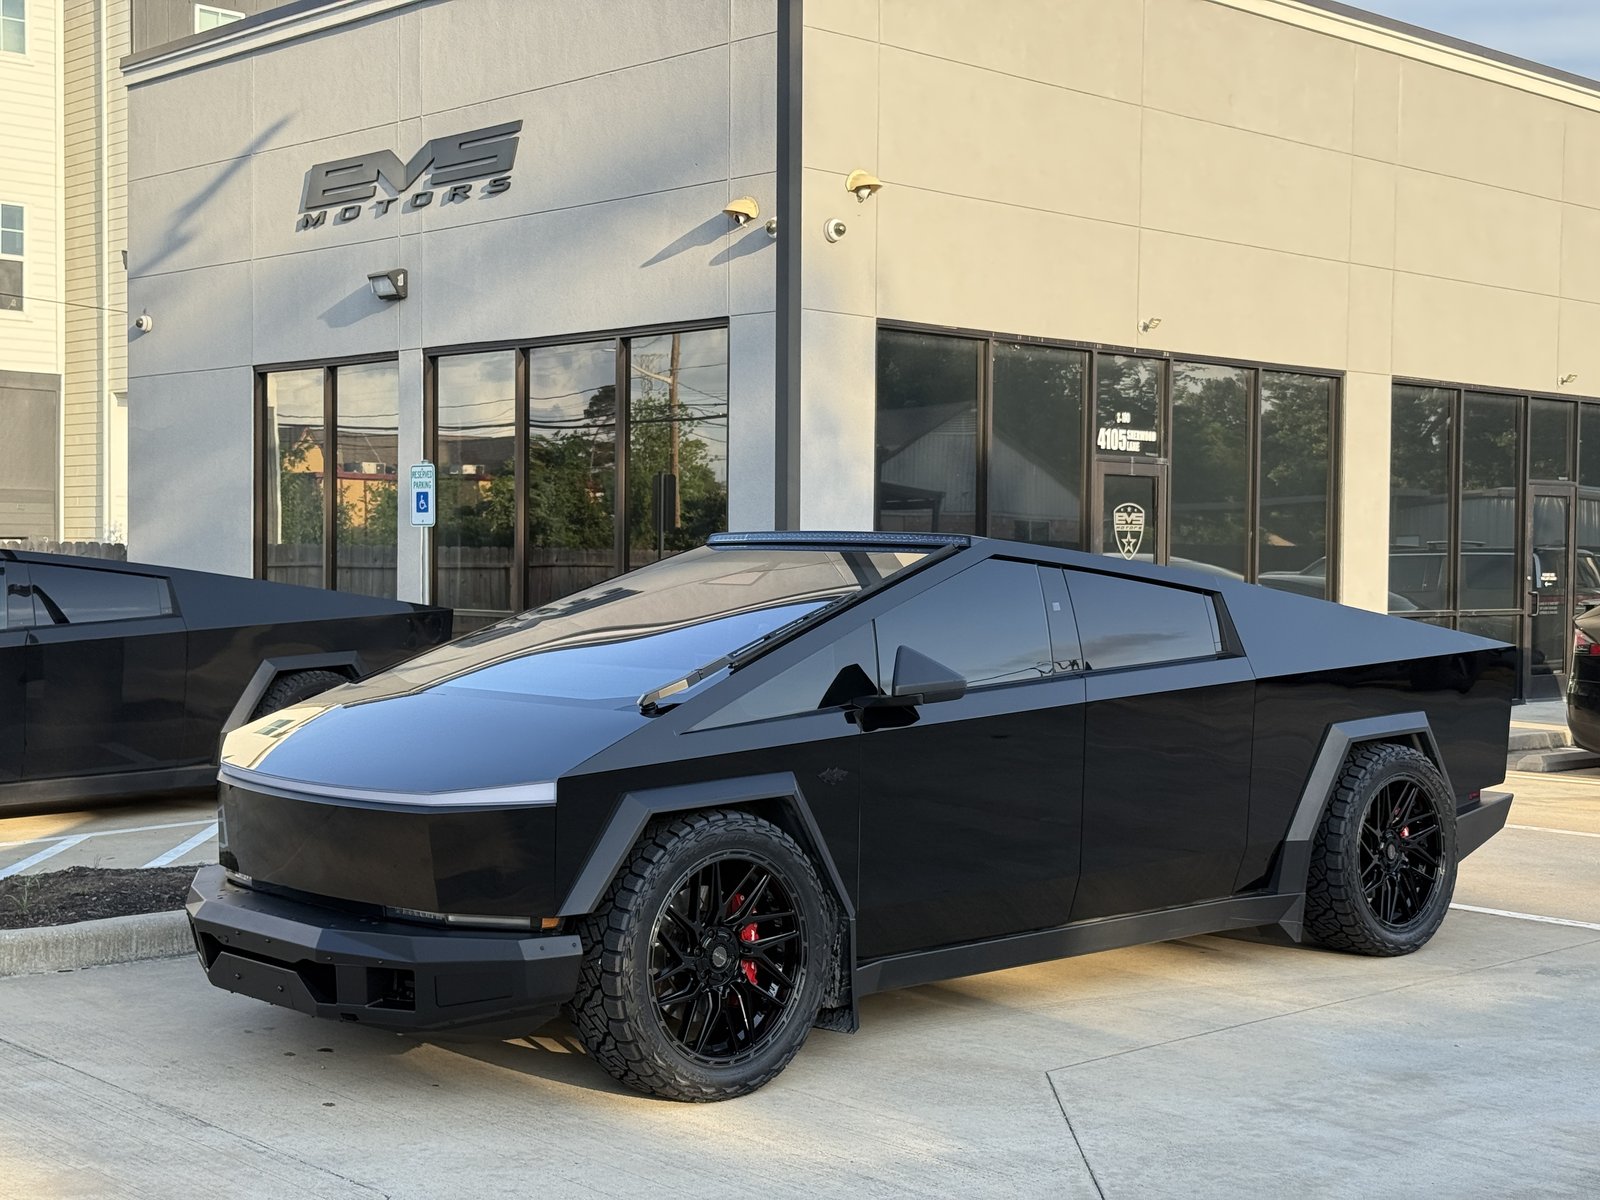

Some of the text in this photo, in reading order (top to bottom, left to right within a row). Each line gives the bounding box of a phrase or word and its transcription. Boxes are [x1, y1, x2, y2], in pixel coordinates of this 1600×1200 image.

[304, 119, 523, 210] EVS
[301, 175, 512, 230] MOTORS
[1097, 427, 1127, 451] 4105
[411, 470, 433, 479] RESERVED
[413, 480, 432, 489] PARKING
[1115, 512, 1143, 525] EVS
